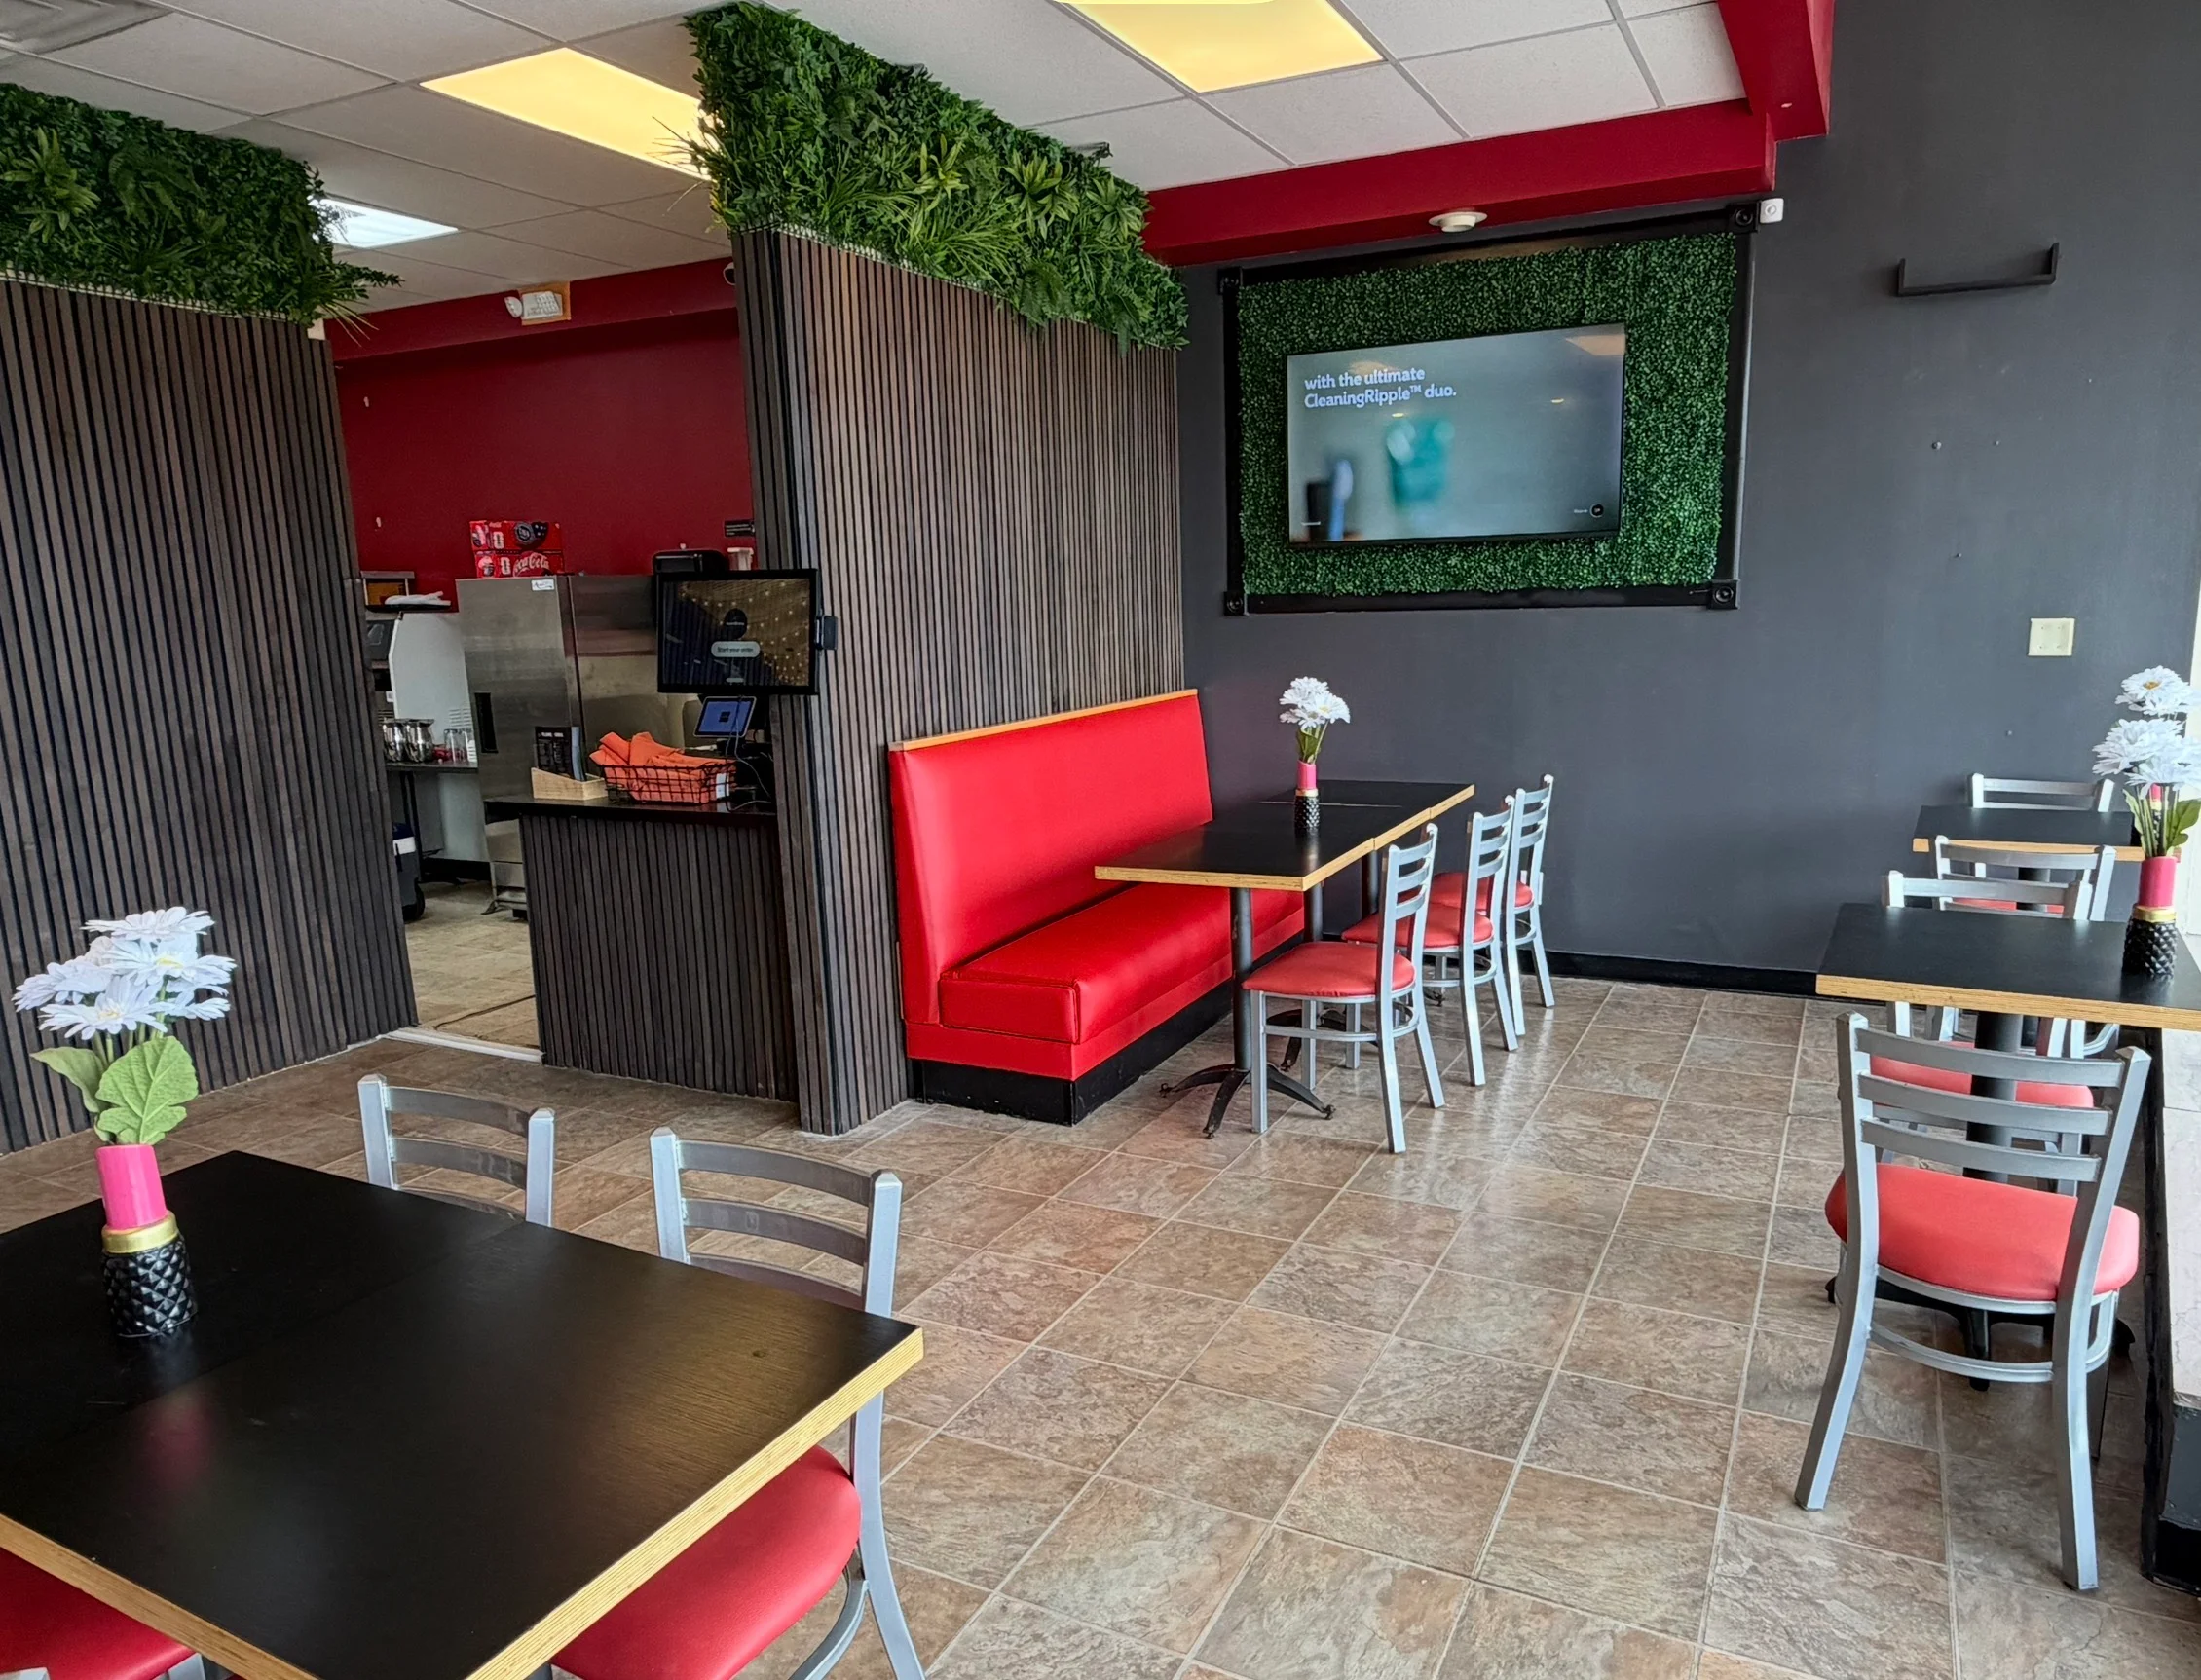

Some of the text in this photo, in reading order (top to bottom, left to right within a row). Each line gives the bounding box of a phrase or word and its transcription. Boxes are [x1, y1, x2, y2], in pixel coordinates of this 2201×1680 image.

[1304, 367, 1426, 390] with the ultimate
[1424, 384, 1457, 398] duo.
